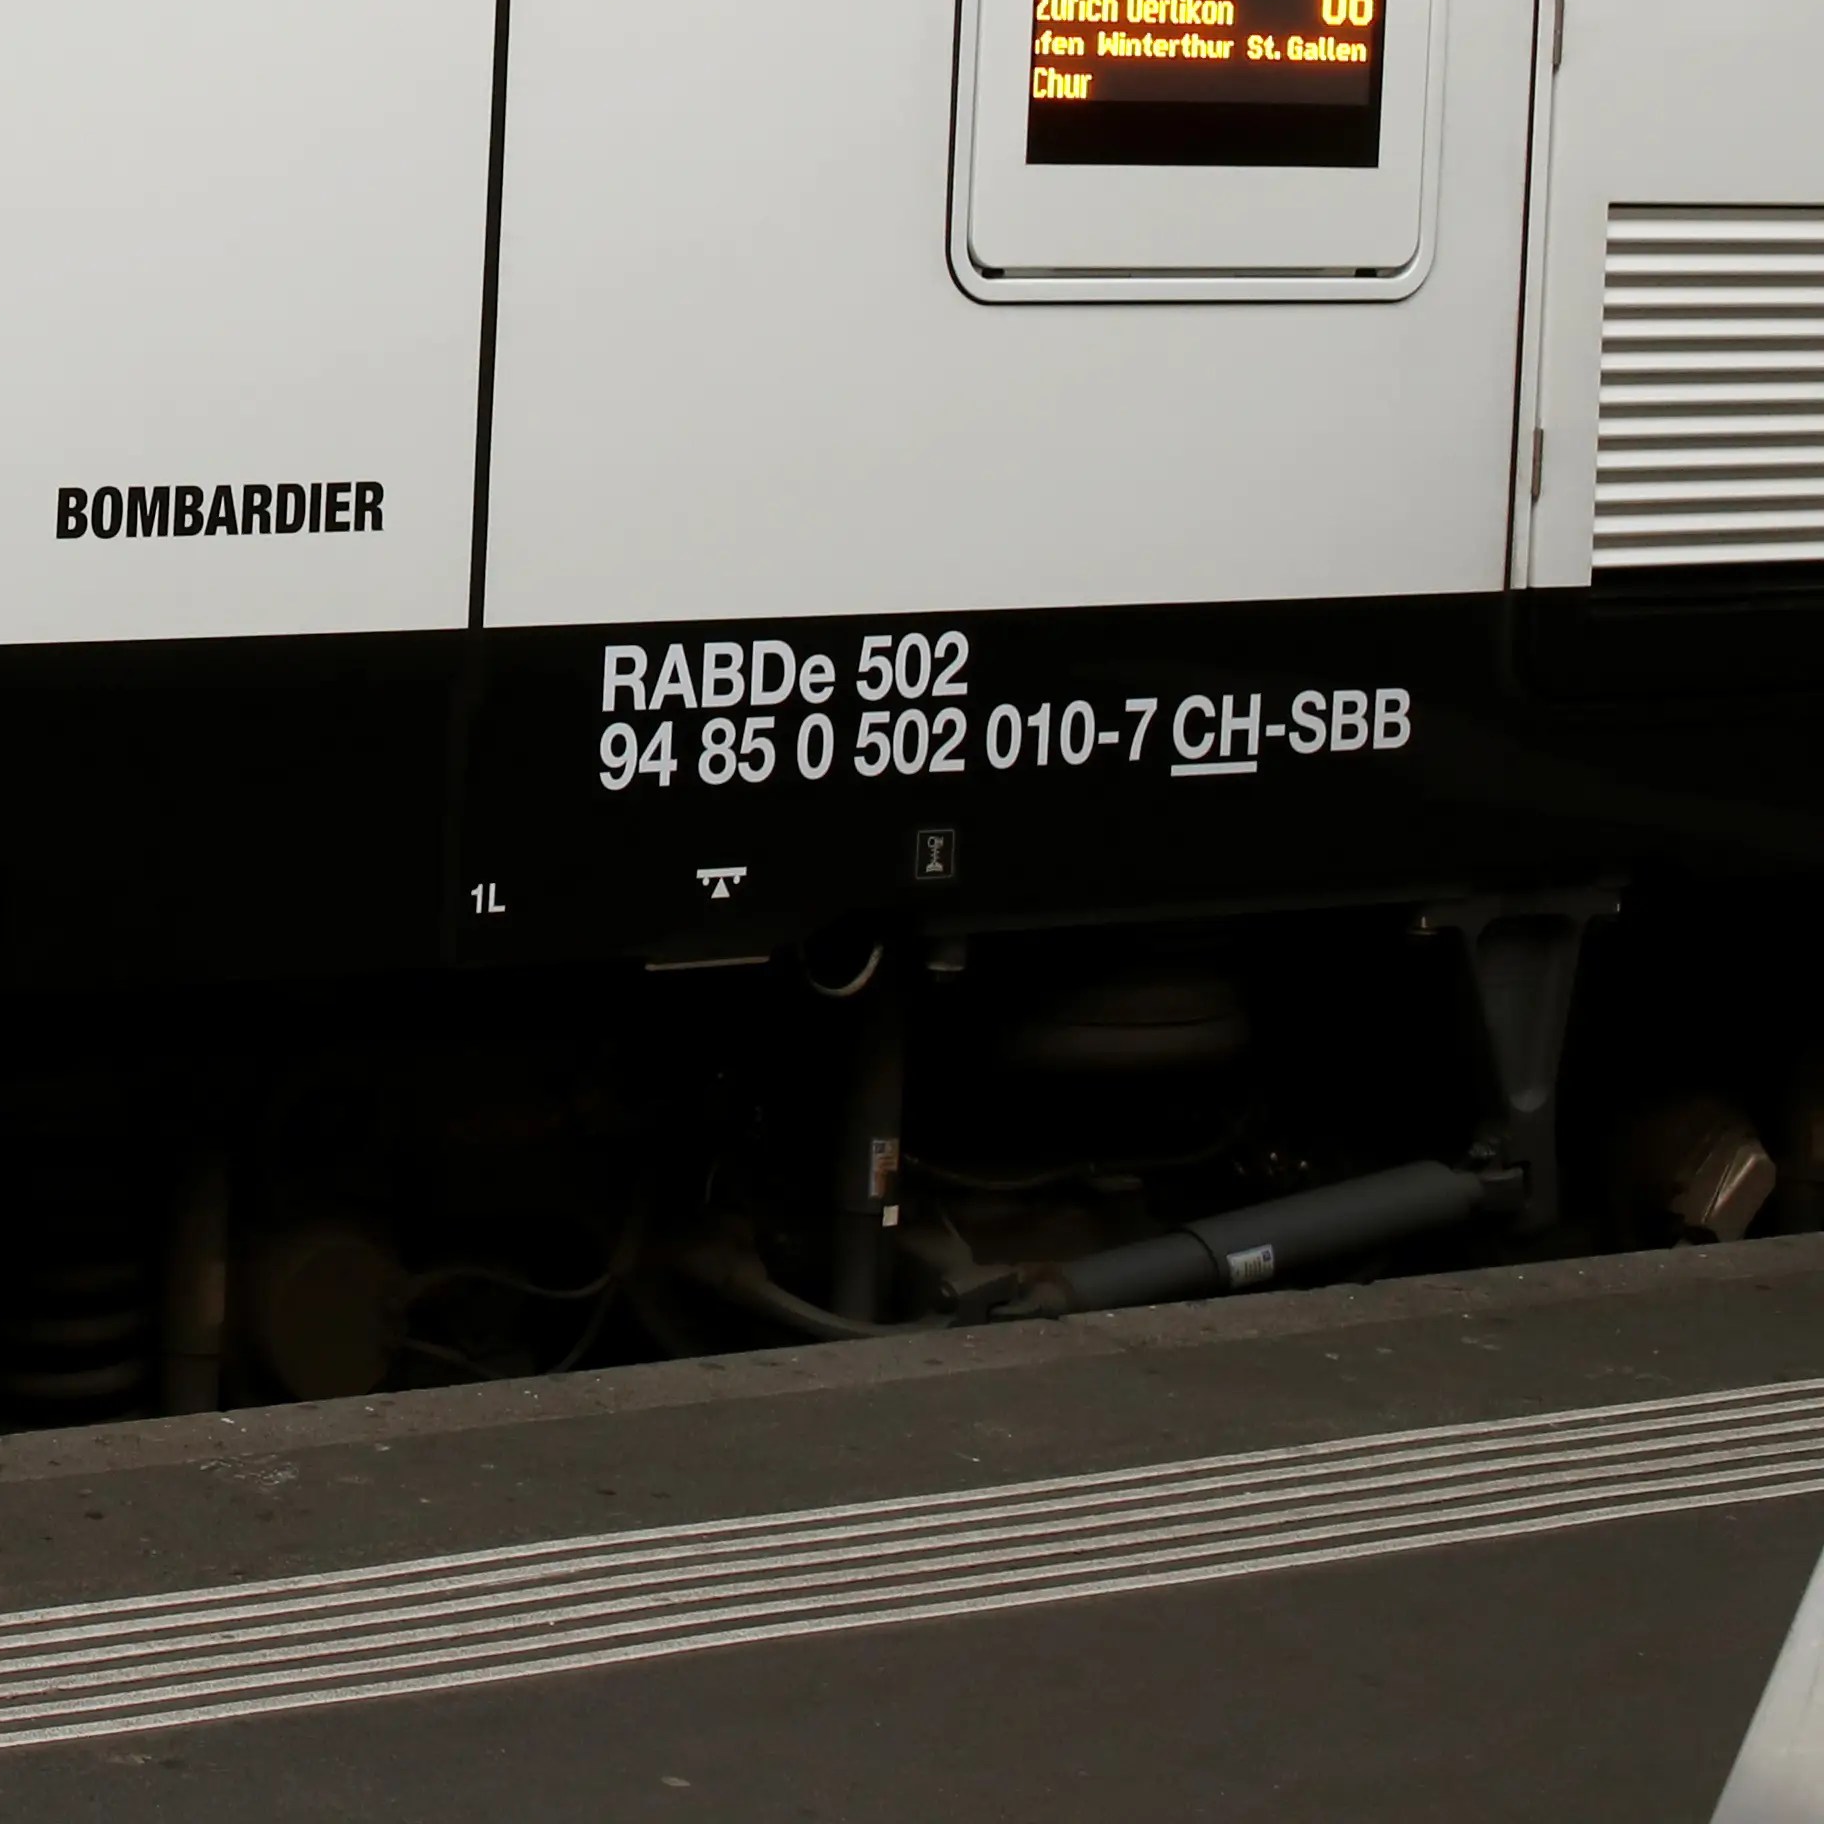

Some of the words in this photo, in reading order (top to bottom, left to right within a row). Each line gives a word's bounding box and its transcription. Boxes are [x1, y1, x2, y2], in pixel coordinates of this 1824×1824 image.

[1034, 29, 1085, 56] fen
[1097, 31, 1235, 59] Winterthur
[1247, 34, 1282, 61] St.
[1287, 35, 1367, 63] Gallen
[1033, 66, 1093, 99] Chur
[56, 481, 384, 540] BOMBARDIER
[602, 639, 836, 712] RABDe
[855, 630, 969, 702] 502
[599, 717, 678, 791] 94
[697, 715, 776, 786] 85
[796, 712, 834, 780] 0
[853, 706, 967, 777] 502
[986, 697, 1158, 770] 010-7
[1171, 687, 1411, 764] CH-SBB
[470, 882, 506, 915] 1L
